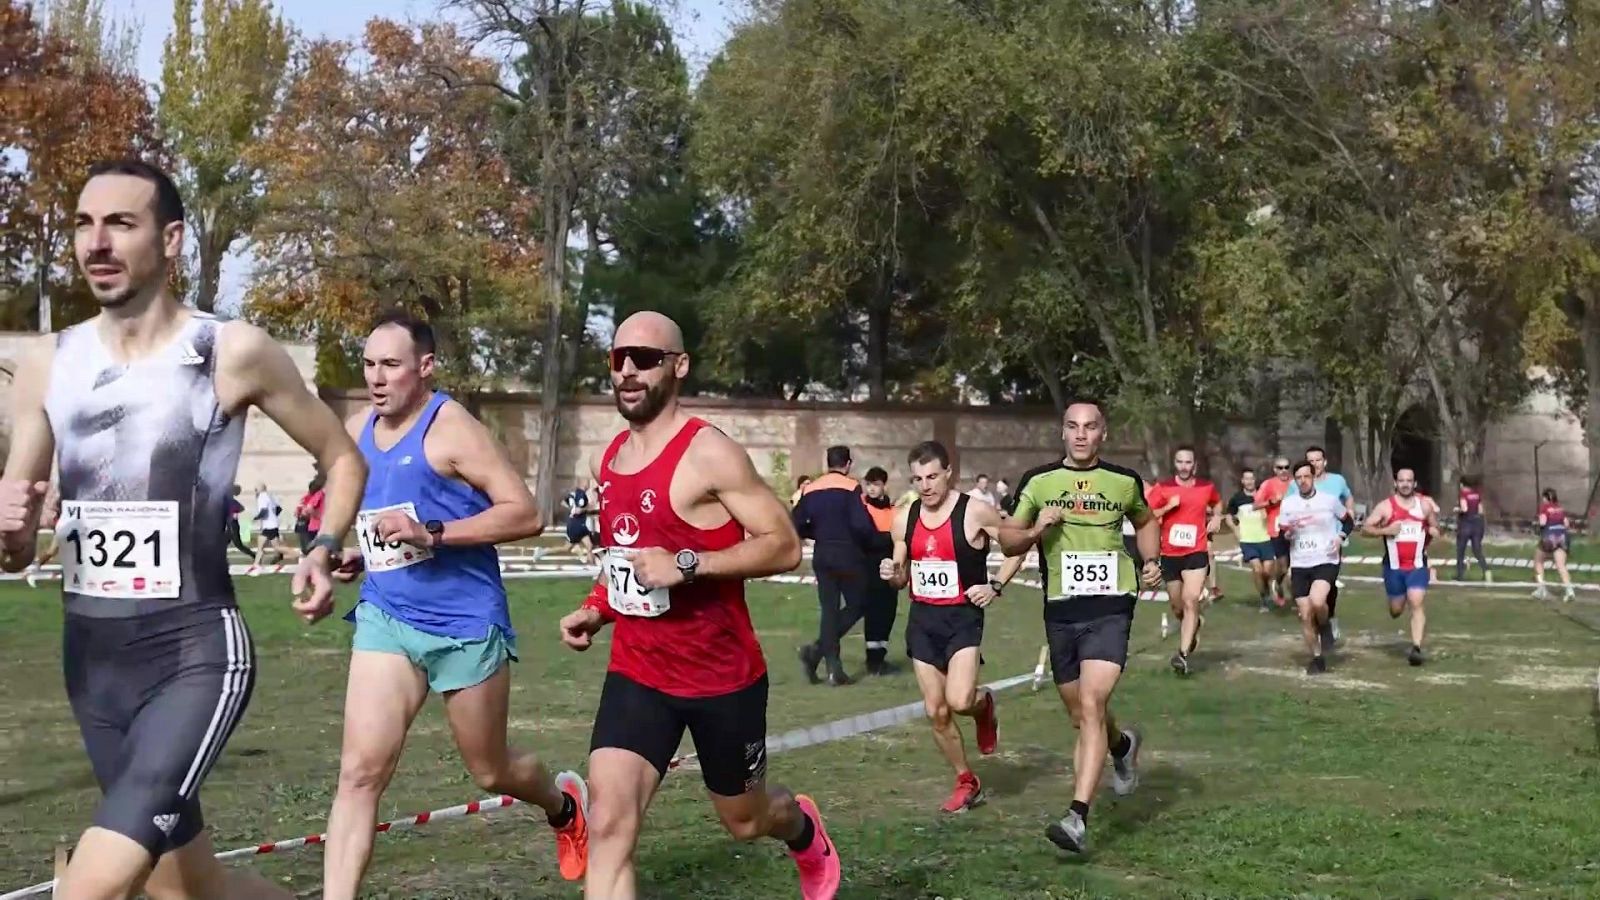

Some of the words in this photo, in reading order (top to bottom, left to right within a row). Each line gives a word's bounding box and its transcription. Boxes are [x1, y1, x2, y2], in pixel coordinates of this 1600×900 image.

[67, 506, 81, 520] VI
[66, 529, 161, 568] 1321
[918, 571, 949, 587] 340
[1073, 564, 1109, 582] 853
